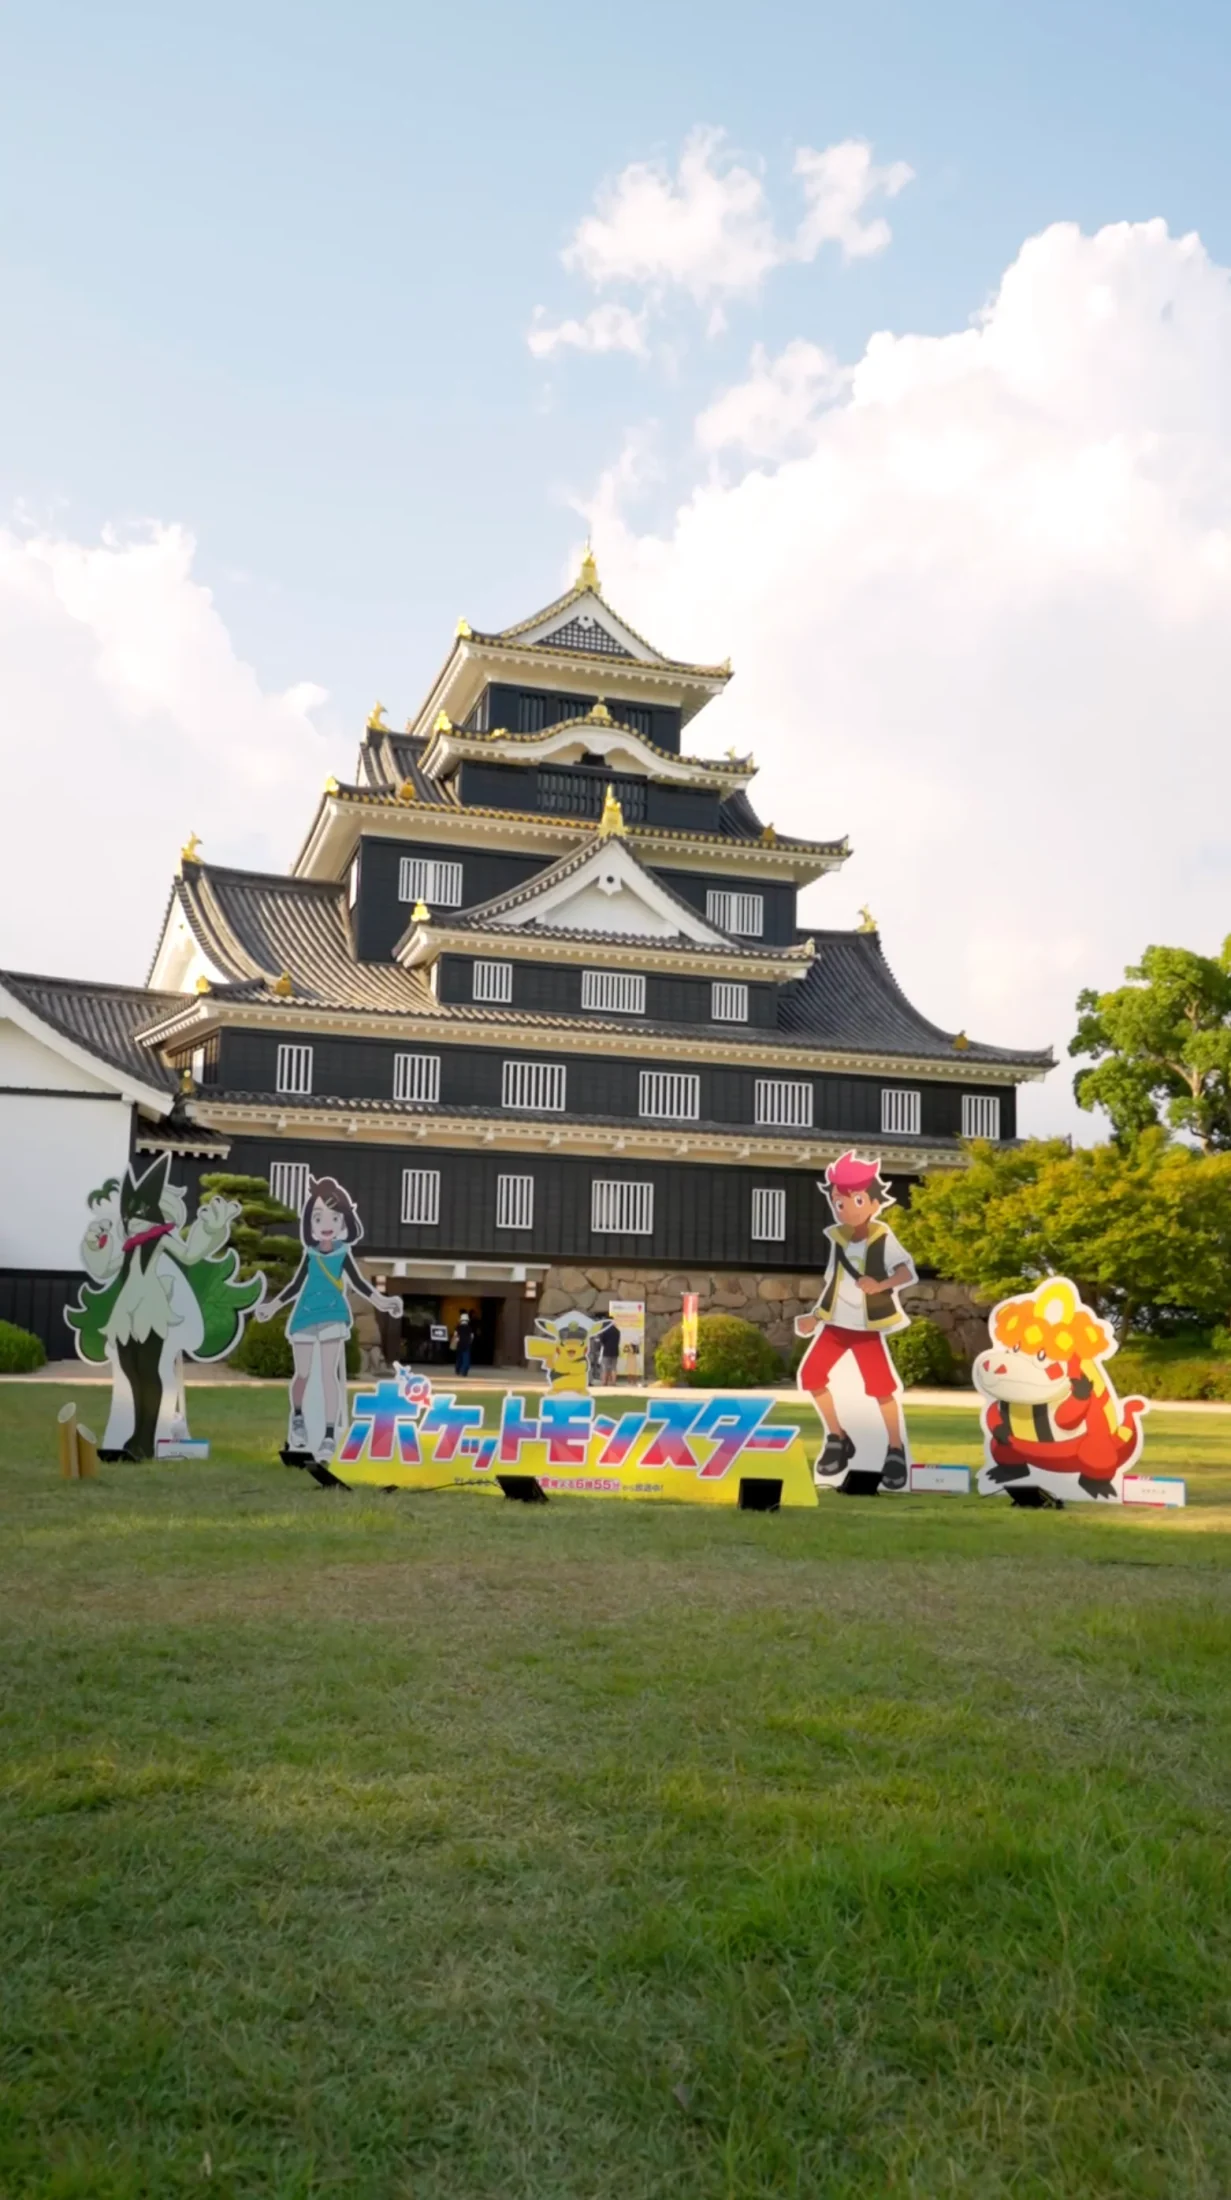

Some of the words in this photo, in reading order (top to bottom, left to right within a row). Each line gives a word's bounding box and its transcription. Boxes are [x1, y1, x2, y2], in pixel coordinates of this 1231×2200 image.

[339, 1374, 800, 1479] ポケットモンスター
